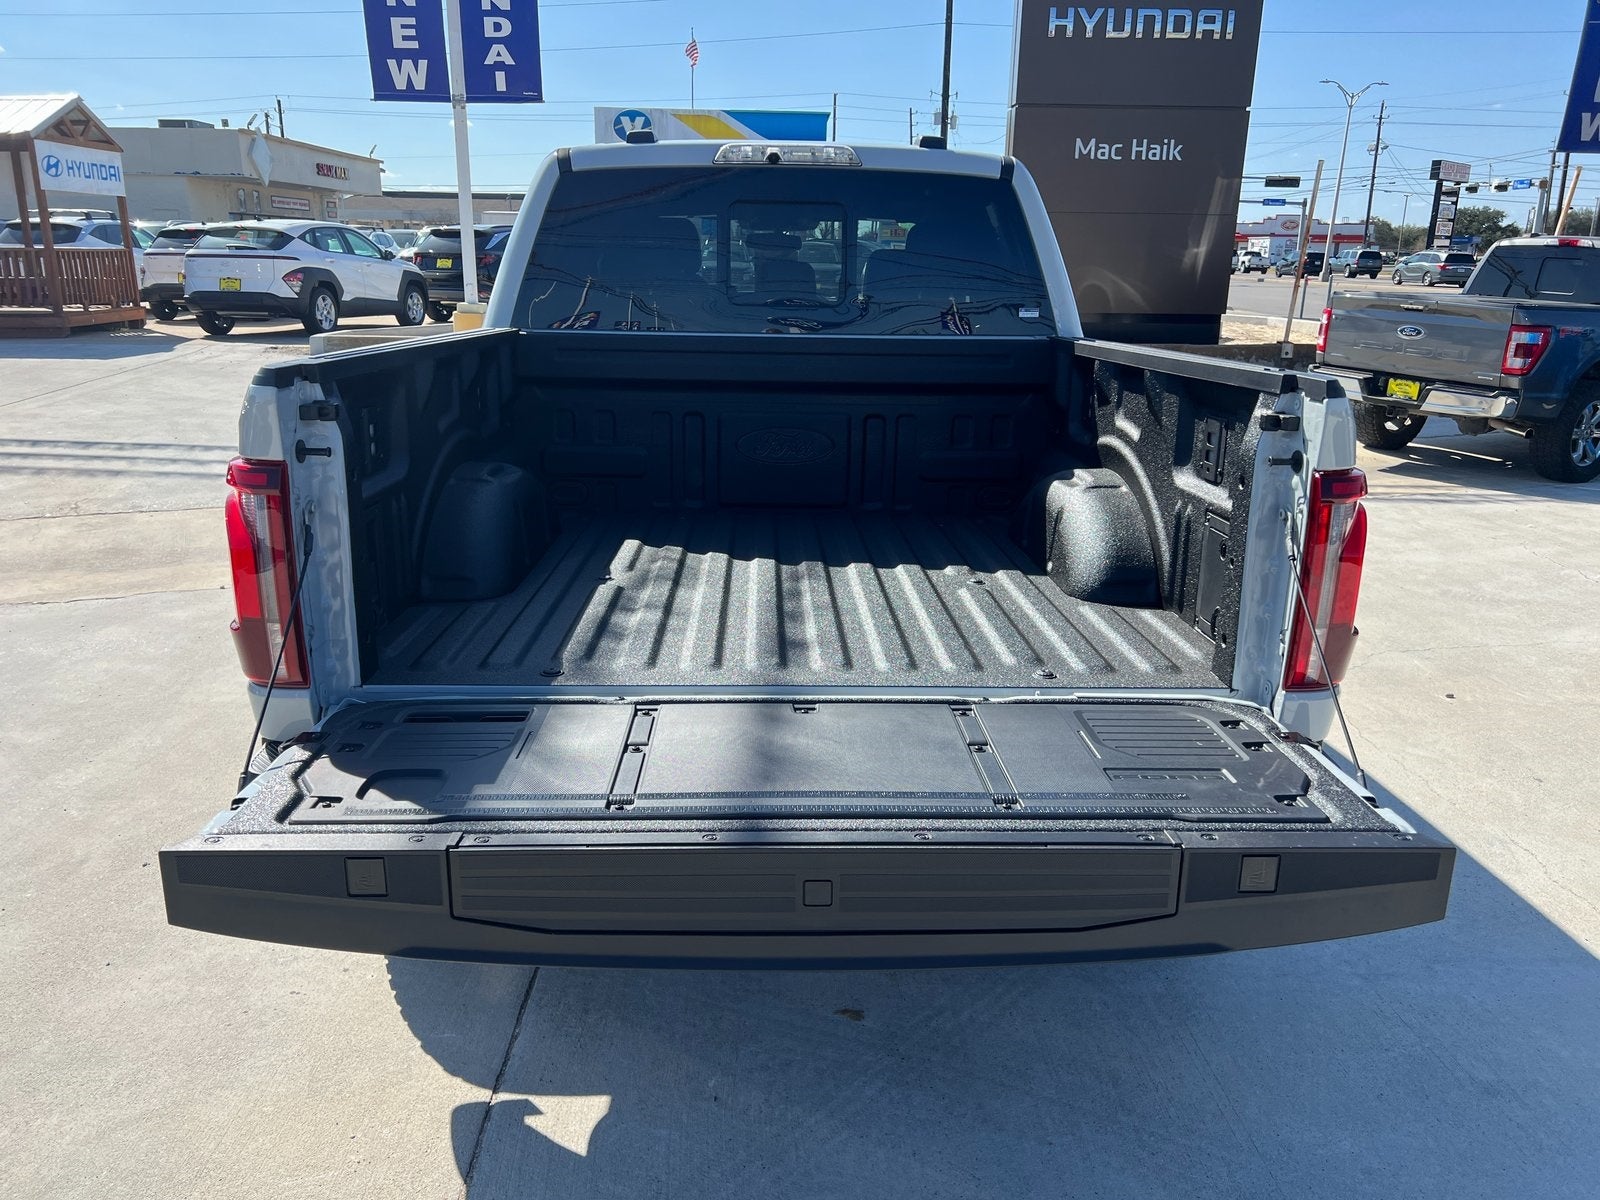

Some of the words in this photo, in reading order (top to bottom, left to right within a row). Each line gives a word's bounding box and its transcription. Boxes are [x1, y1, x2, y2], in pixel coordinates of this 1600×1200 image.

[1048, 6, 1236, 39] HYUNDAI
[386, 0, 428, 90] EW
[1074, 137, 1123, 160] Mac
[1131, 138, 1183, 161] Haik
[66, 160, 121, 182] HYUNDAI
